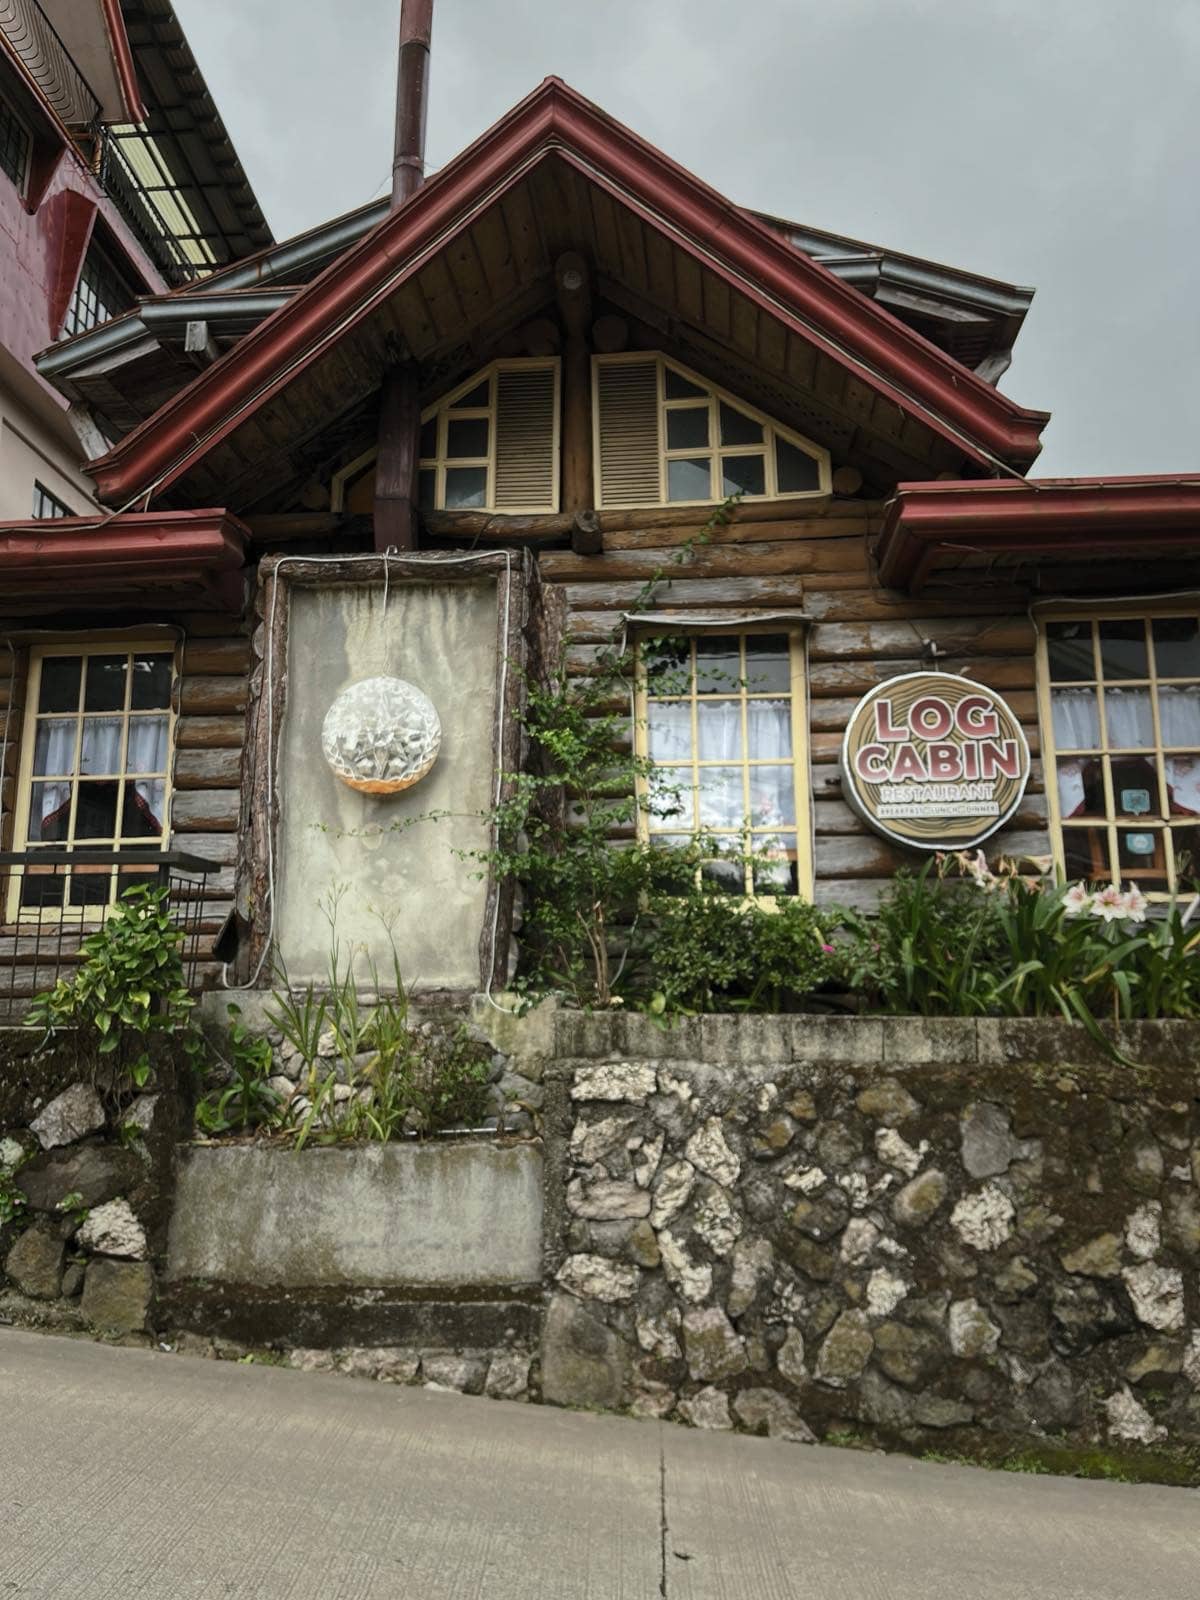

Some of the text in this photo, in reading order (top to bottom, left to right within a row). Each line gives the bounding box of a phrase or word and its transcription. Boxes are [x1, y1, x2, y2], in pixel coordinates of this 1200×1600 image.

[874, 695, 1000, 742] LOG
[856, 739, 1021, 784] CABIN
[880, 783, 995, 802] RESTAURANT
